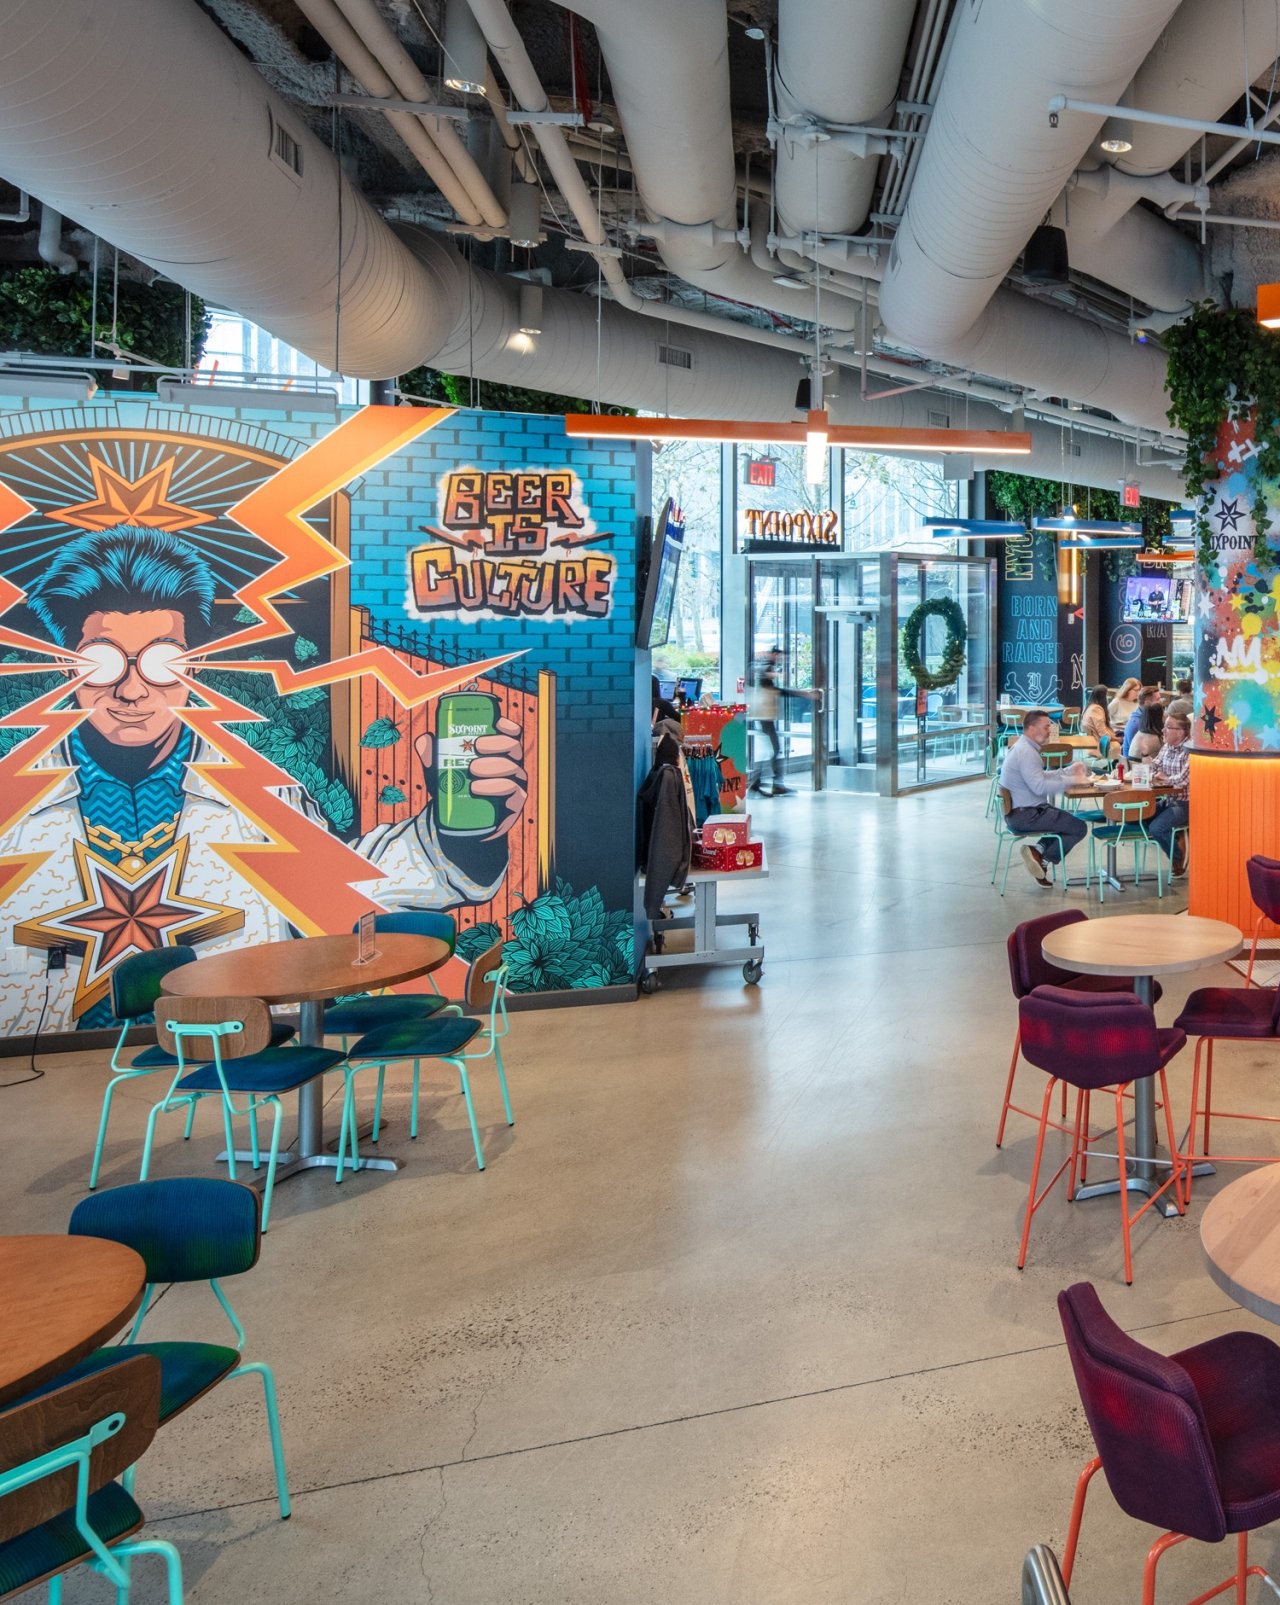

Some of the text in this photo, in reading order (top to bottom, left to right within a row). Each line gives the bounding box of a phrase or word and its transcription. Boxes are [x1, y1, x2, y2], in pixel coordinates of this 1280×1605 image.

[750, 463, 775, 486] EXIT
[443, 472, 584, 529] BEER
[484, 514, 548, 557] IS
[1209, 533, 1259, 550] IXPOINT
[411, 547, 612, 618] CULTURE
[1011, 595, 1058, 617] BORN
[1016, 618, 1053, 640] AND
[448, 724, 488, 735] SIXPOINT
